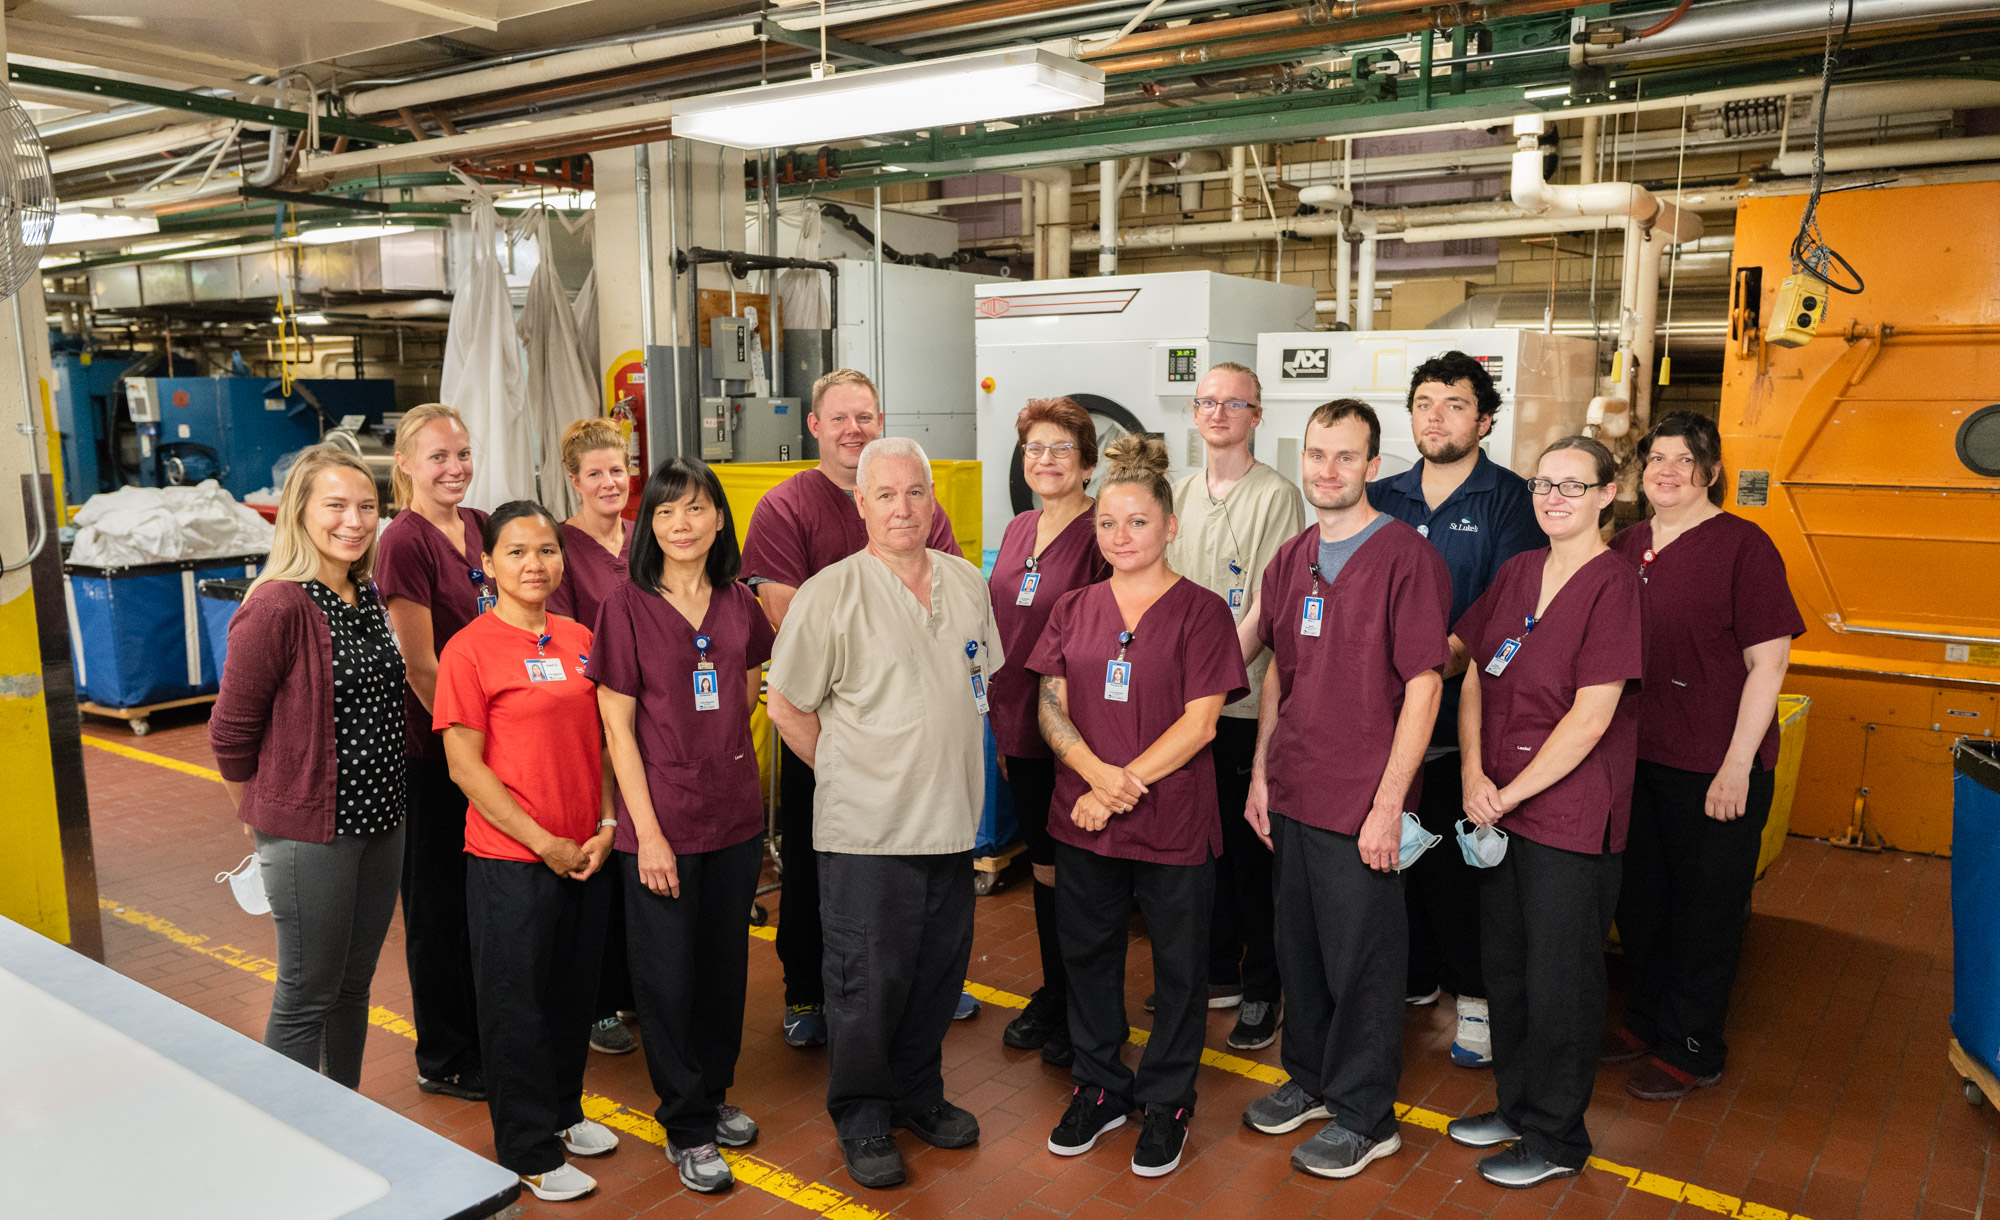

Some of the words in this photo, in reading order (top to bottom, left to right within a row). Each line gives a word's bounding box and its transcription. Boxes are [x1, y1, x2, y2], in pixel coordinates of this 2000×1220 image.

[1292, 349, 1326, 368] ADC
[781, 445, 788, 461] ON
[1458, 524, 1478, 532] Luke's
